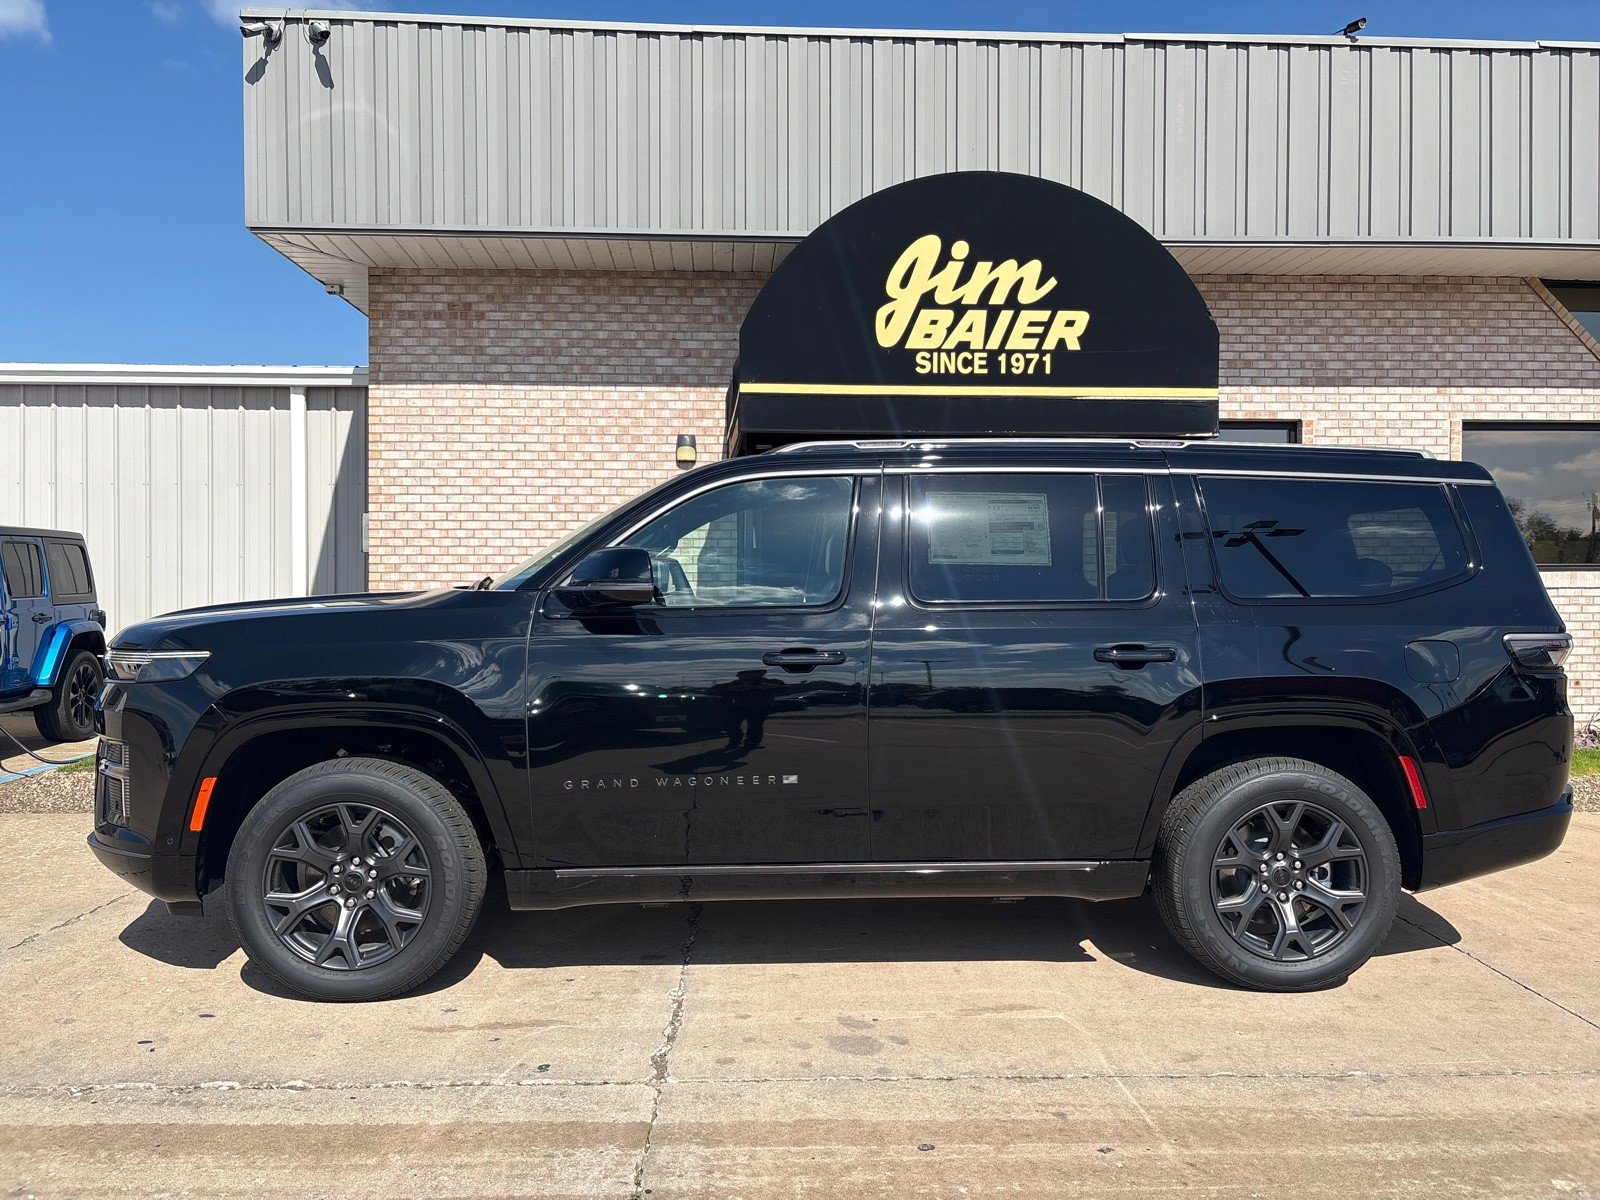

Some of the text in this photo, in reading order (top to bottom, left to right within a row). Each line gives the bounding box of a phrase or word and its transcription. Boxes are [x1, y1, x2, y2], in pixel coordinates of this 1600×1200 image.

[875, 234, 1058, 348] Jim
[904, 309, 1090, 350] BAIER
[915, 351, 1051, 375] SINCE 1971
[563, 775, 777, 790] GRAND WAGONEER
[1303, 778, 1385, 843] ROADIAN
[430, 835, 456, 938] ROADIAN
[1188, 878, 1248, 973] NEXEN
